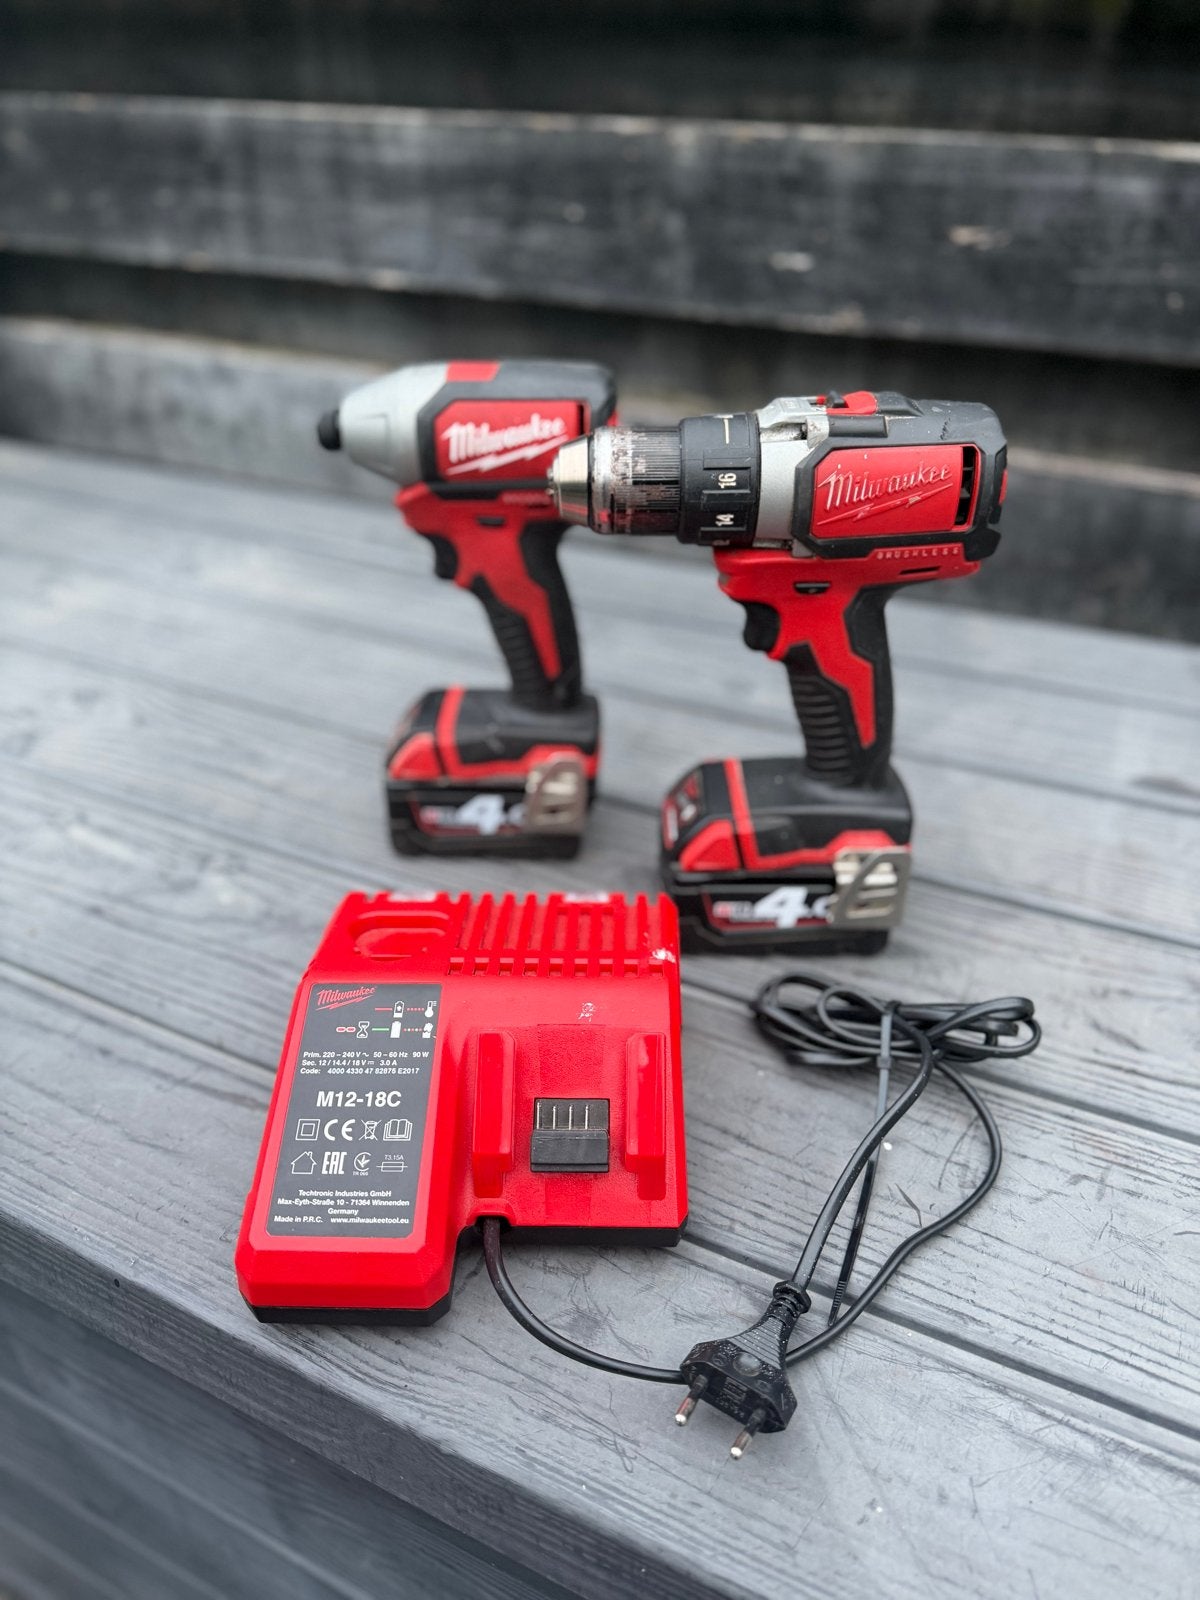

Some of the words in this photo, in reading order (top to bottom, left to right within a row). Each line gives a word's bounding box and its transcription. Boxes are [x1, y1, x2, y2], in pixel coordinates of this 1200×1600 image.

[441, 412, 566, 464] Milwaukee
[717, 472, 737, 489] 16
[817, 462, 953, 512] Milwaukee
[715, 513, 734, 527] 14
[316, 986, 377, 1007] Milwaukee
[316, 1090, 402, 1108] M12-18C
[323, 1119, 356, 1141] CE
[328, 1208, 359, 1216] Germany
